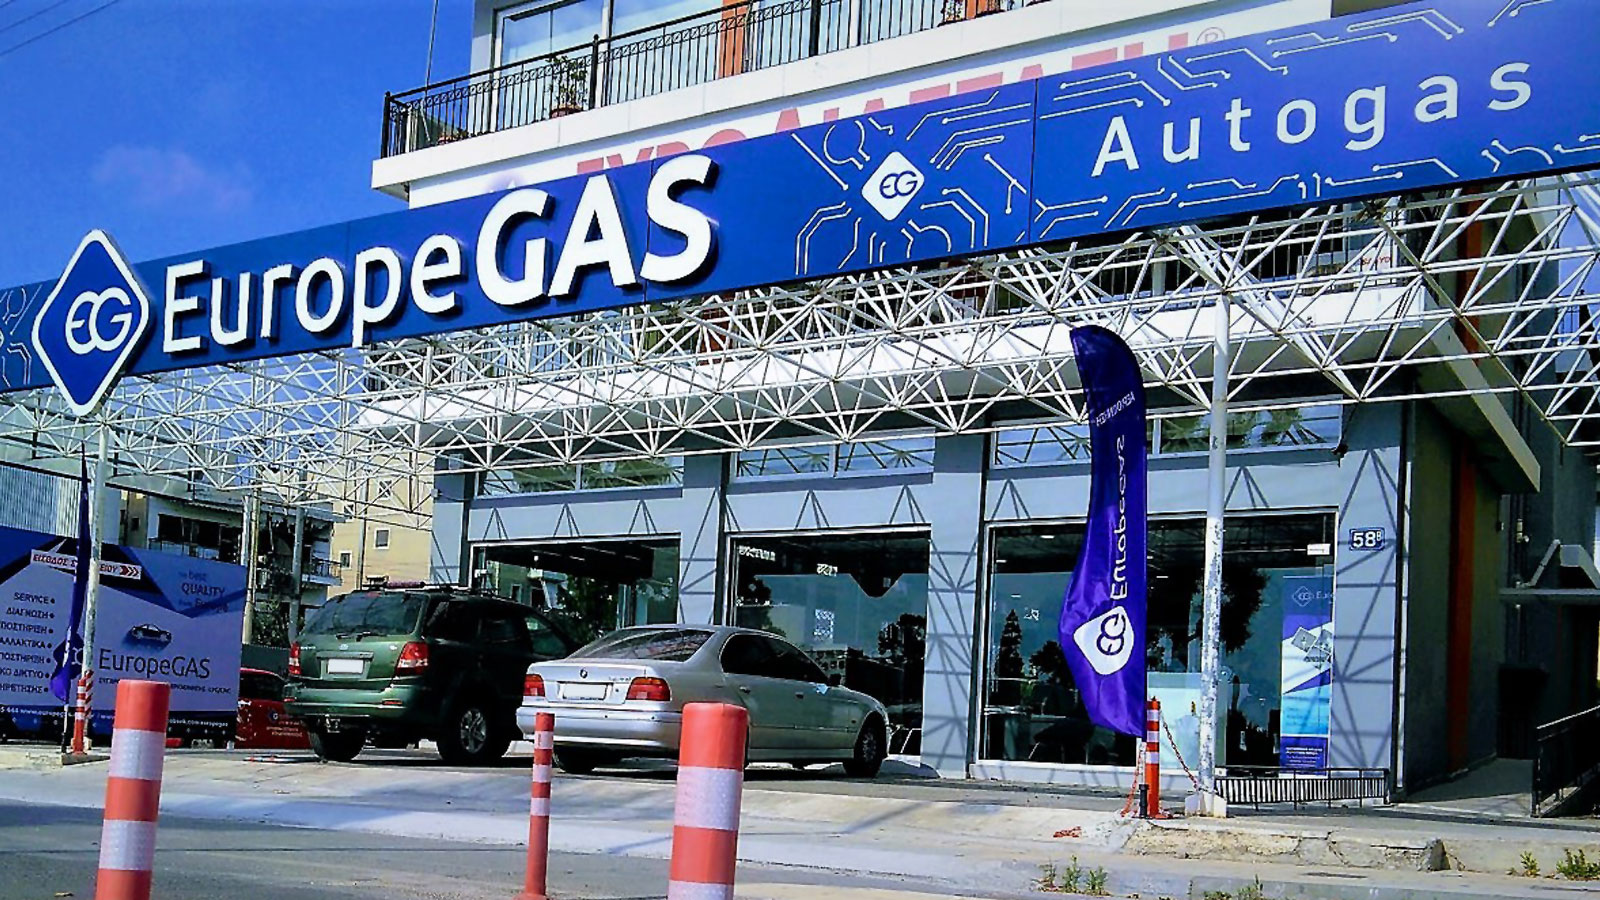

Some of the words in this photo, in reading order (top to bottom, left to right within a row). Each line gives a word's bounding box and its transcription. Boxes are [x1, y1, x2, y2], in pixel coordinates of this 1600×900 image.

[1091, 61, 1532, 178] Autogas
[162, 154, 720, 348] EuropeGAS
[13, 592, 49, 604] SERVICE
[182, 583, 225, 597] QUALITY
[98, 647, 212, 679] EuropeGAS
